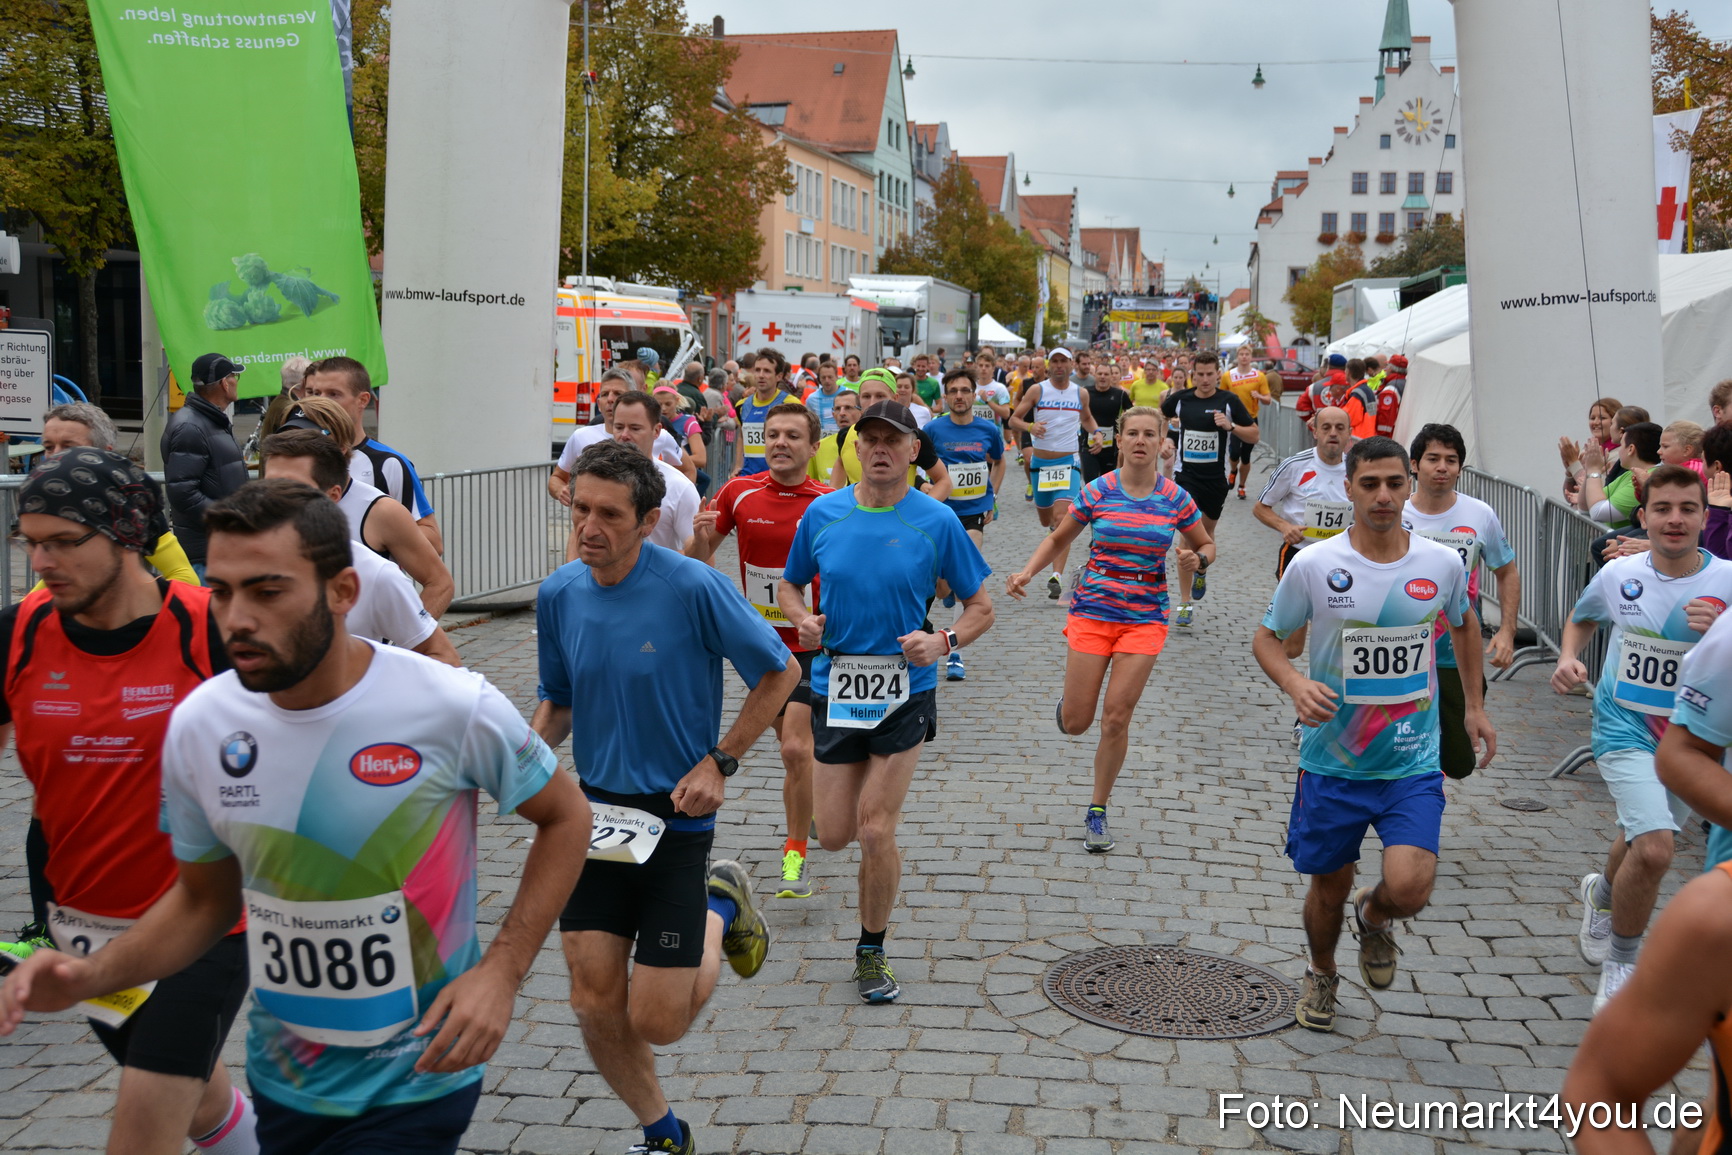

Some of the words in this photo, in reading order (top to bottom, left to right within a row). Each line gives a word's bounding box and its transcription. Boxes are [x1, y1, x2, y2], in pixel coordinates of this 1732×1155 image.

[385, 287, 526, 306] www.bmw-laufsport.de
[1500, 289, 1656, 310] www.bmw-laufsport.de
[785, 322, 822, 330] Bayerisches
[7, 342, 46, 355] Richtung
[1, 355, 31, 365] sbräu-
[14, 368, 35, 378] über
[973, 410, 993, 420] 2648
[1187, 438, 1216, 452] 2284
[957, 472, 982, 487] 206
[1046, 470, 1065, 481] 145
[1315, 511, 1344, 528] 154
[747, 569, 766, 580] PARTL
[1409, 583, 1435, 595] Hervis
[1619, 603, 1642, 611] PARTL
[1345, 635, 1376, 643] PARTL
[1377, 633, 1418, 643] Neumarkt
[1624, 639, 1648, 651] PARTL
[1353, 642, 1424, 675] 3087
[857, 663, 895, 671] Neumarkt
[1626, 652, 1679, 688] 308
[122, 684, 174, 697] HEINLOTH
[837, 673, 903, 700] 2024
[1395, 721, 1415, 735] 16.
[71, 735, 135, 746] Gruber
[359, 754, 415, 775] Hervis
[219, 785, 260, 798] PARTL
[220, 798, 260, 808] Neumarkt
[602, 814, 646, 829] Neumarkt
[592, 826, 638, 850] 27
[250, 904, 290, 927] PARTL
[291, 914, 375, 930] Neumarkt
[262, 931, 396, 990] 3086
